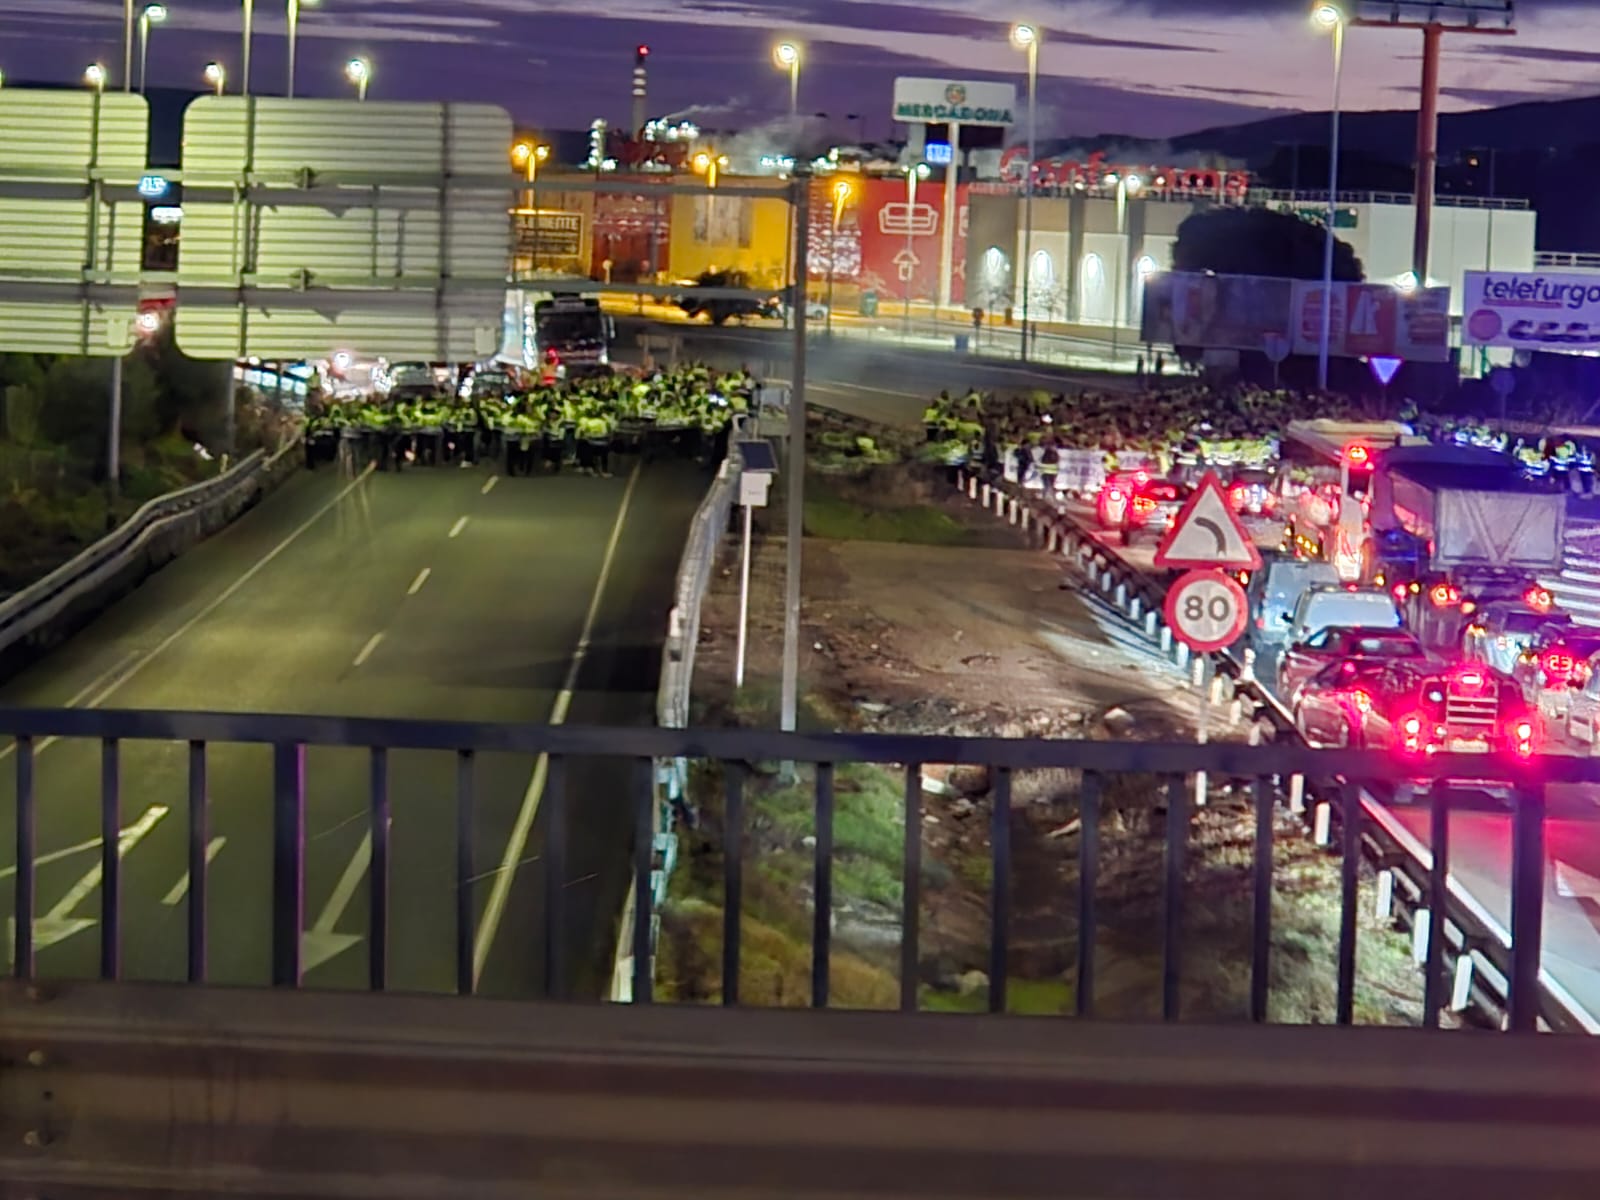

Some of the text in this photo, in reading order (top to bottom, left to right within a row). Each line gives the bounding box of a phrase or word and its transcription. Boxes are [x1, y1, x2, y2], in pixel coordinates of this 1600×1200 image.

[896, 103, 1014, 122] MERCADONA
[1483, 277, 1600, 309] telefurgo
[1184, 595, 1230, 622] 80
